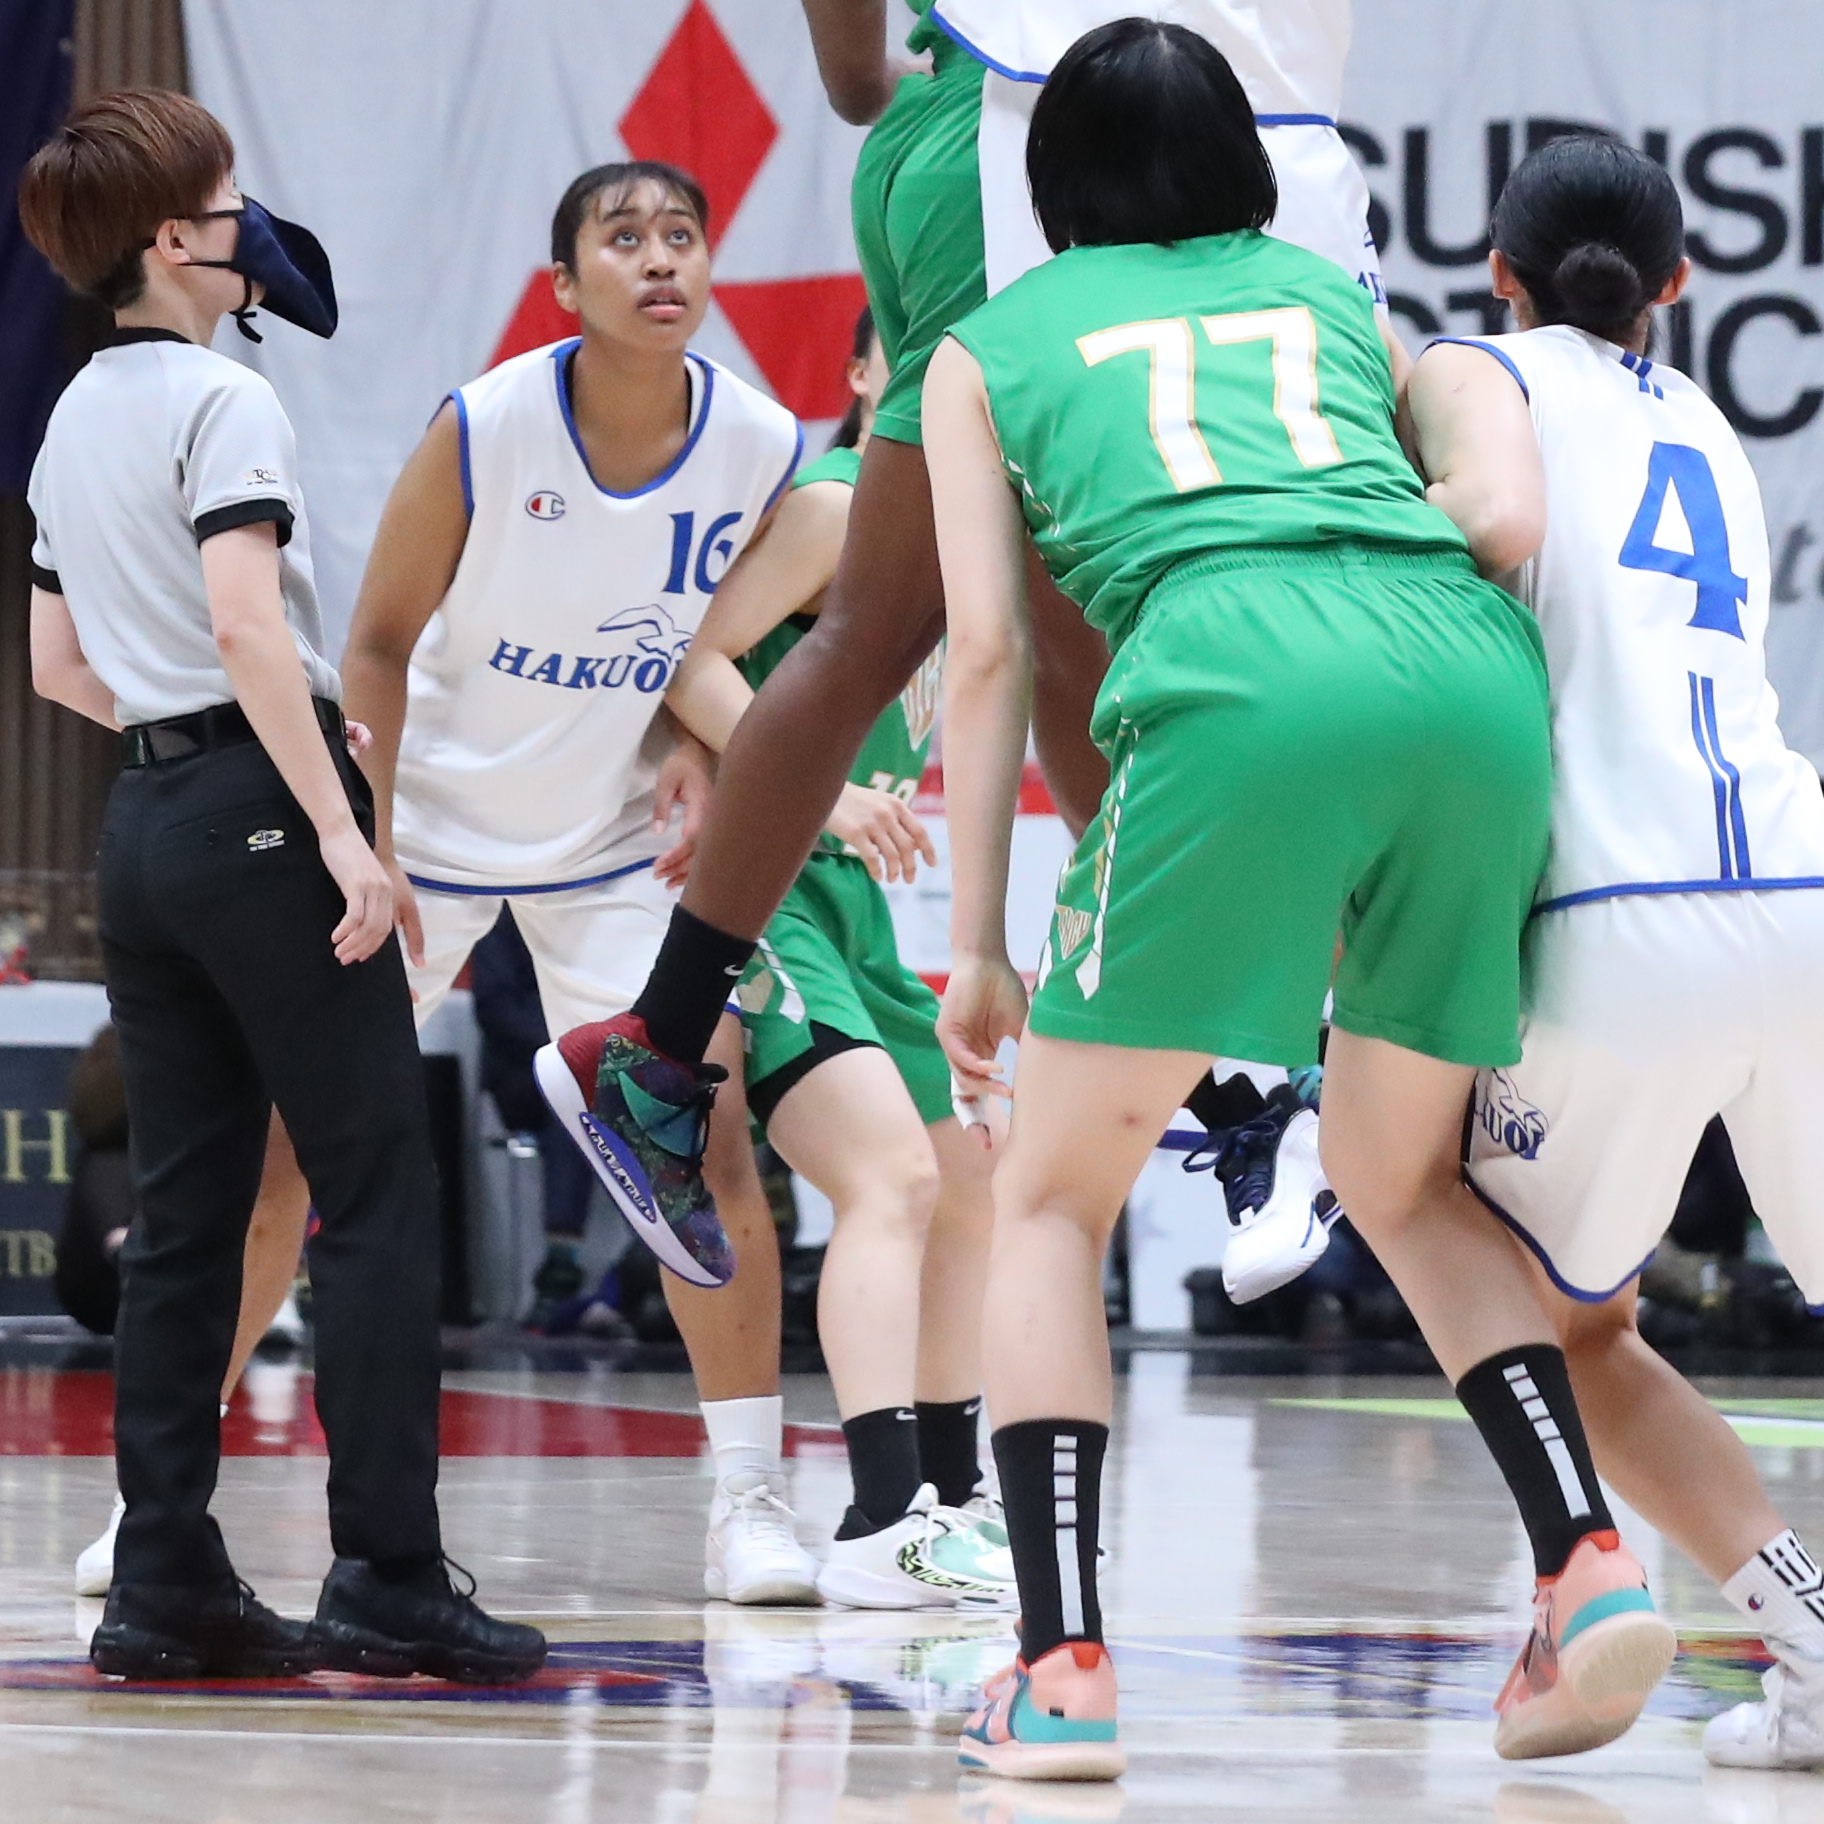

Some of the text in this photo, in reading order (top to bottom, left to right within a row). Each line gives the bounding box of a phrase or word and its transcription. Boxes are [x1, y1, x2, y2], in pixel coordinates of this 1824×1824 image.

[1076, 305, 1343, 492] 77
[663, 511, 744, 596] 16
[1617, 440, 1749, 643] 4
[488, 637, 681, 694] HAKUO
